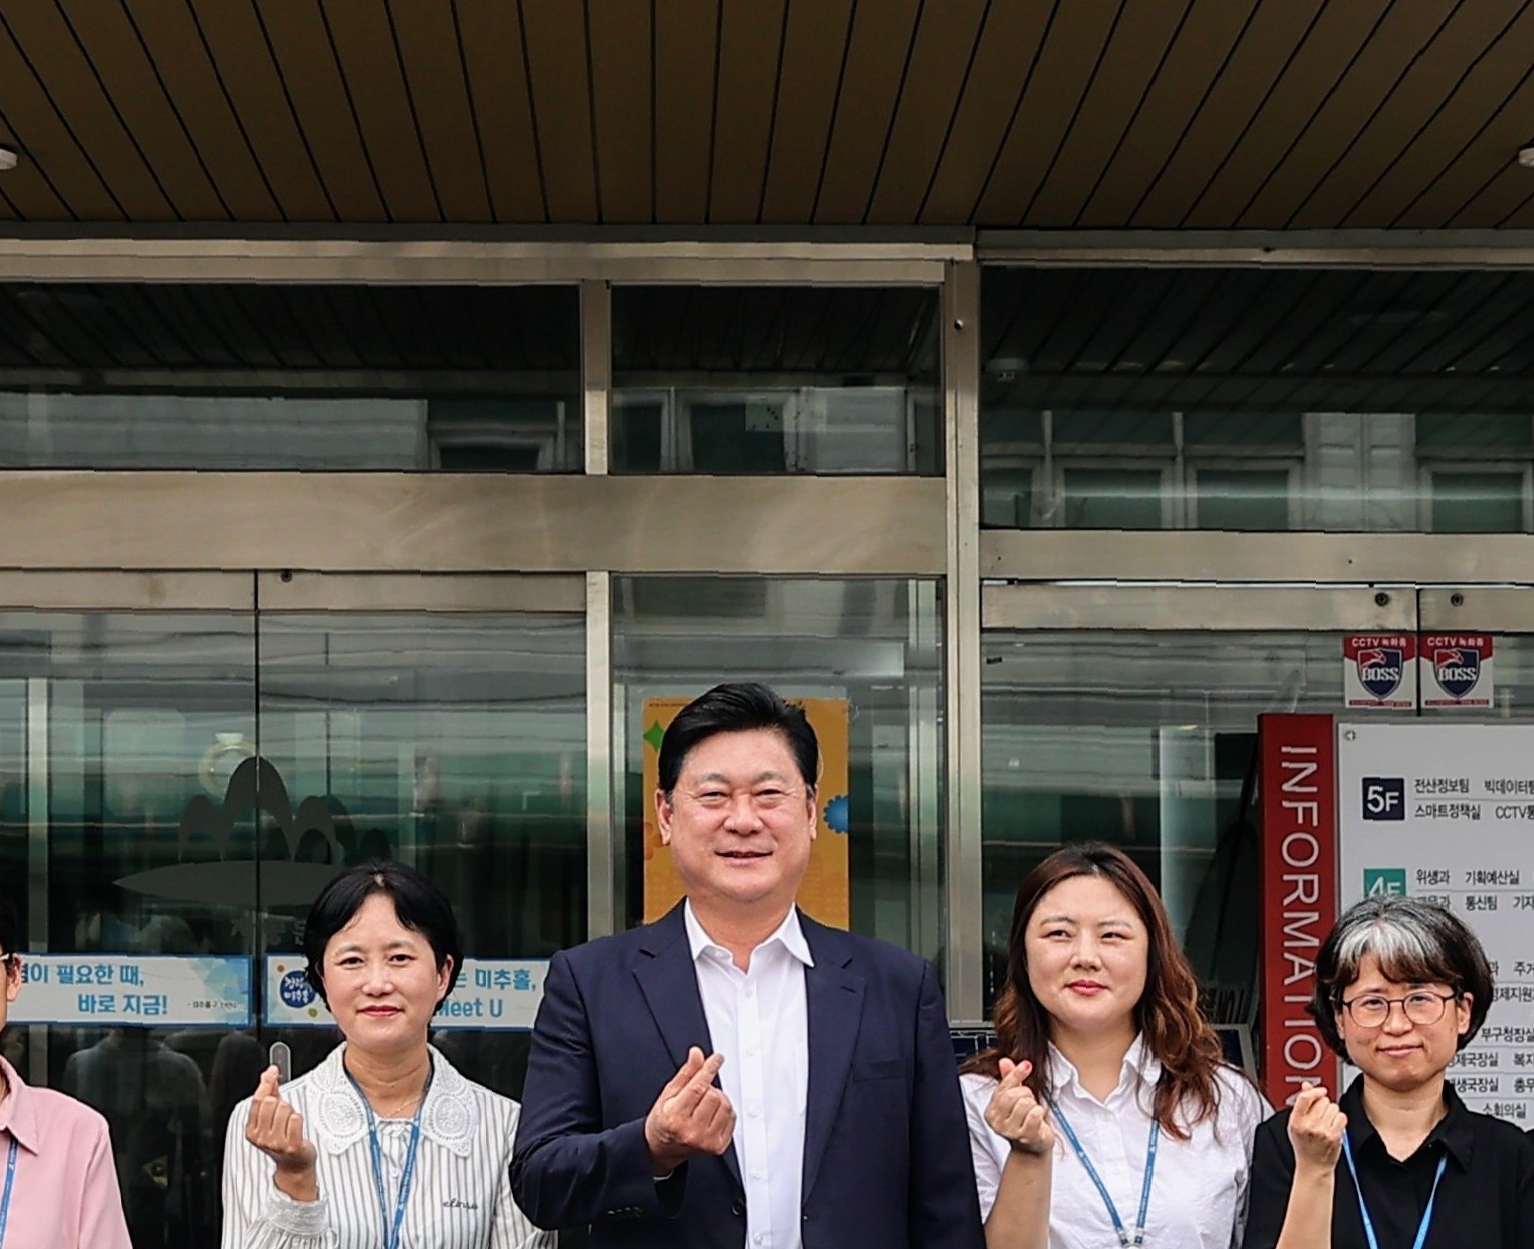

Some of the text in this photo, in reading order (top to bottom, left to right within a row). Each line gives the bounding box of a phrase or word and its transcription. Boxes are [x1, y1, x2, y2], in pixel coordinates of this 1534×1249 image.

[1352, 638, 1379, 647] CCTV
[1427, 637, 1456, 646] CCTV
[1362, 667, 1399, 681] BOSS
[1439, 667, 1476, 681] BOSS
[1414, 778, 1470, 794] 전산정보팀
[1367, 786, 1399, 813] 5F
[1414, 804, 1481, 820] 스마트정책실
[1416, 870, 1450, 885] 위생과
[1465, 870, 1520, 886] 기획예산실
[1465, 896, 1498, 911] 통신팀
[57, 962, 114, 985] 필요한
[120, 963, 145, 986] 때,
[475, 968, 536, 991] 미추홀,
[78, 994, 168, 1015] 바로 지금!
[490, 999, 503, 1018] U
[1452, 1077, 1499, 1093] 생국장실
